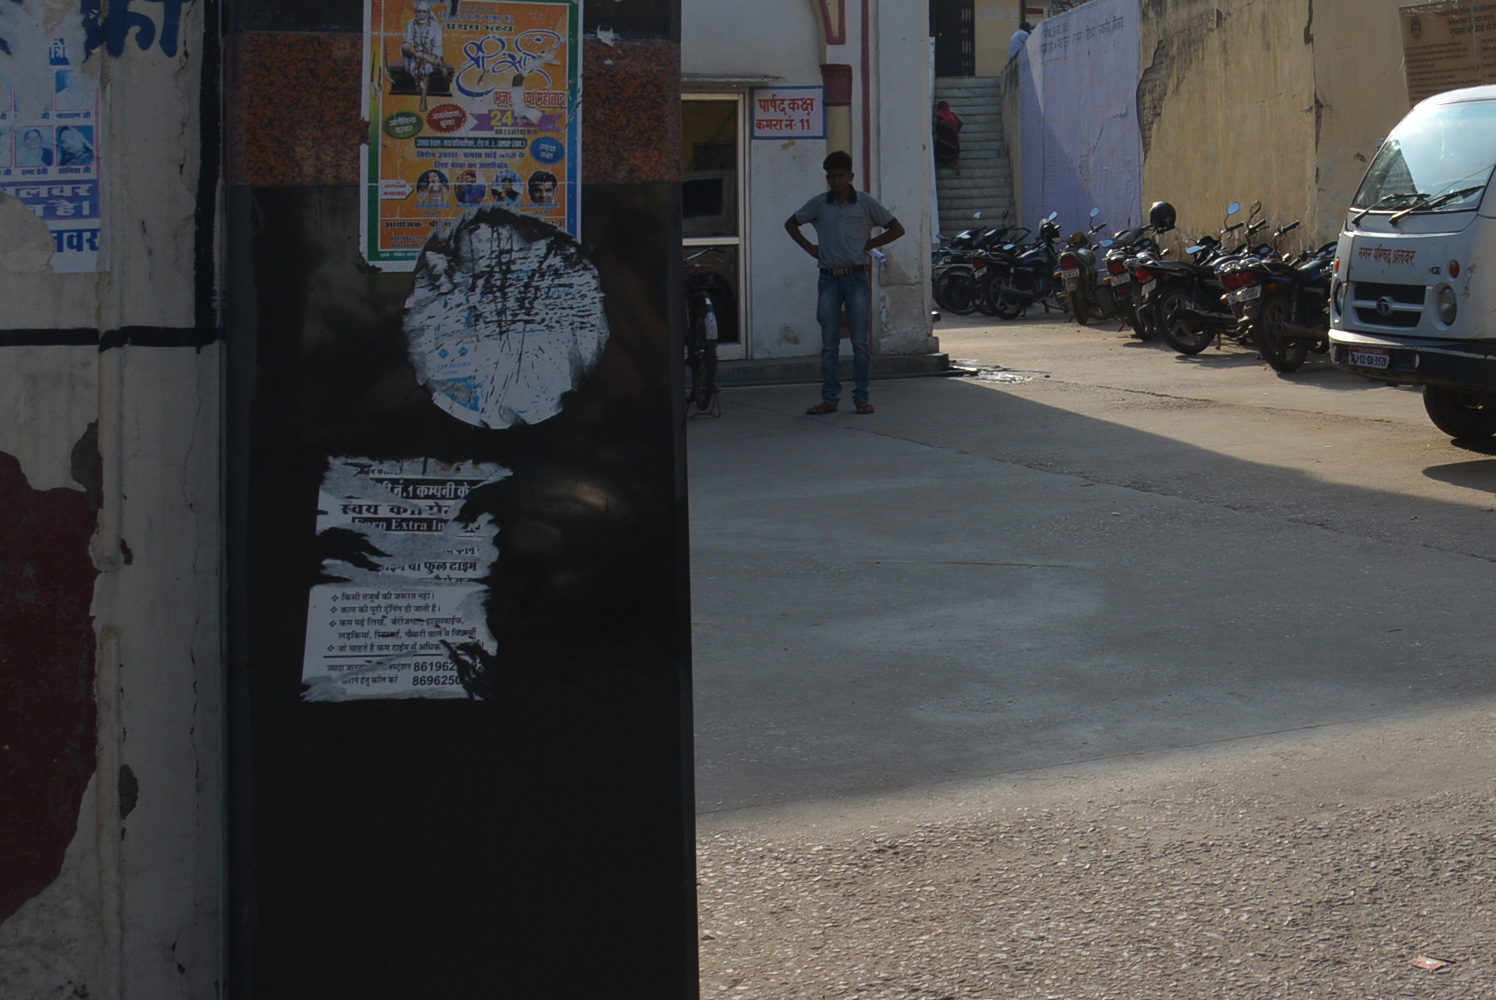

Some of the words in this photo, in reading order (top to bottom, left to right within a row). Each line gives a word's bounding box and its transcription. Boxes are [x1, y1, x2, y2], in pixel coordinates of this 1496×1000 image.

[757, 93, 787, 116] पार्षद
[787, 97, 816, 116] कक्ष
[490, 109, 514, 127] 24
[756, 118, 784, 132] कमरा
[799, 118, 811, 131] 11
[415, 481, 456, 498] कम्पनी
[391, 519, 428, 531] Extra
